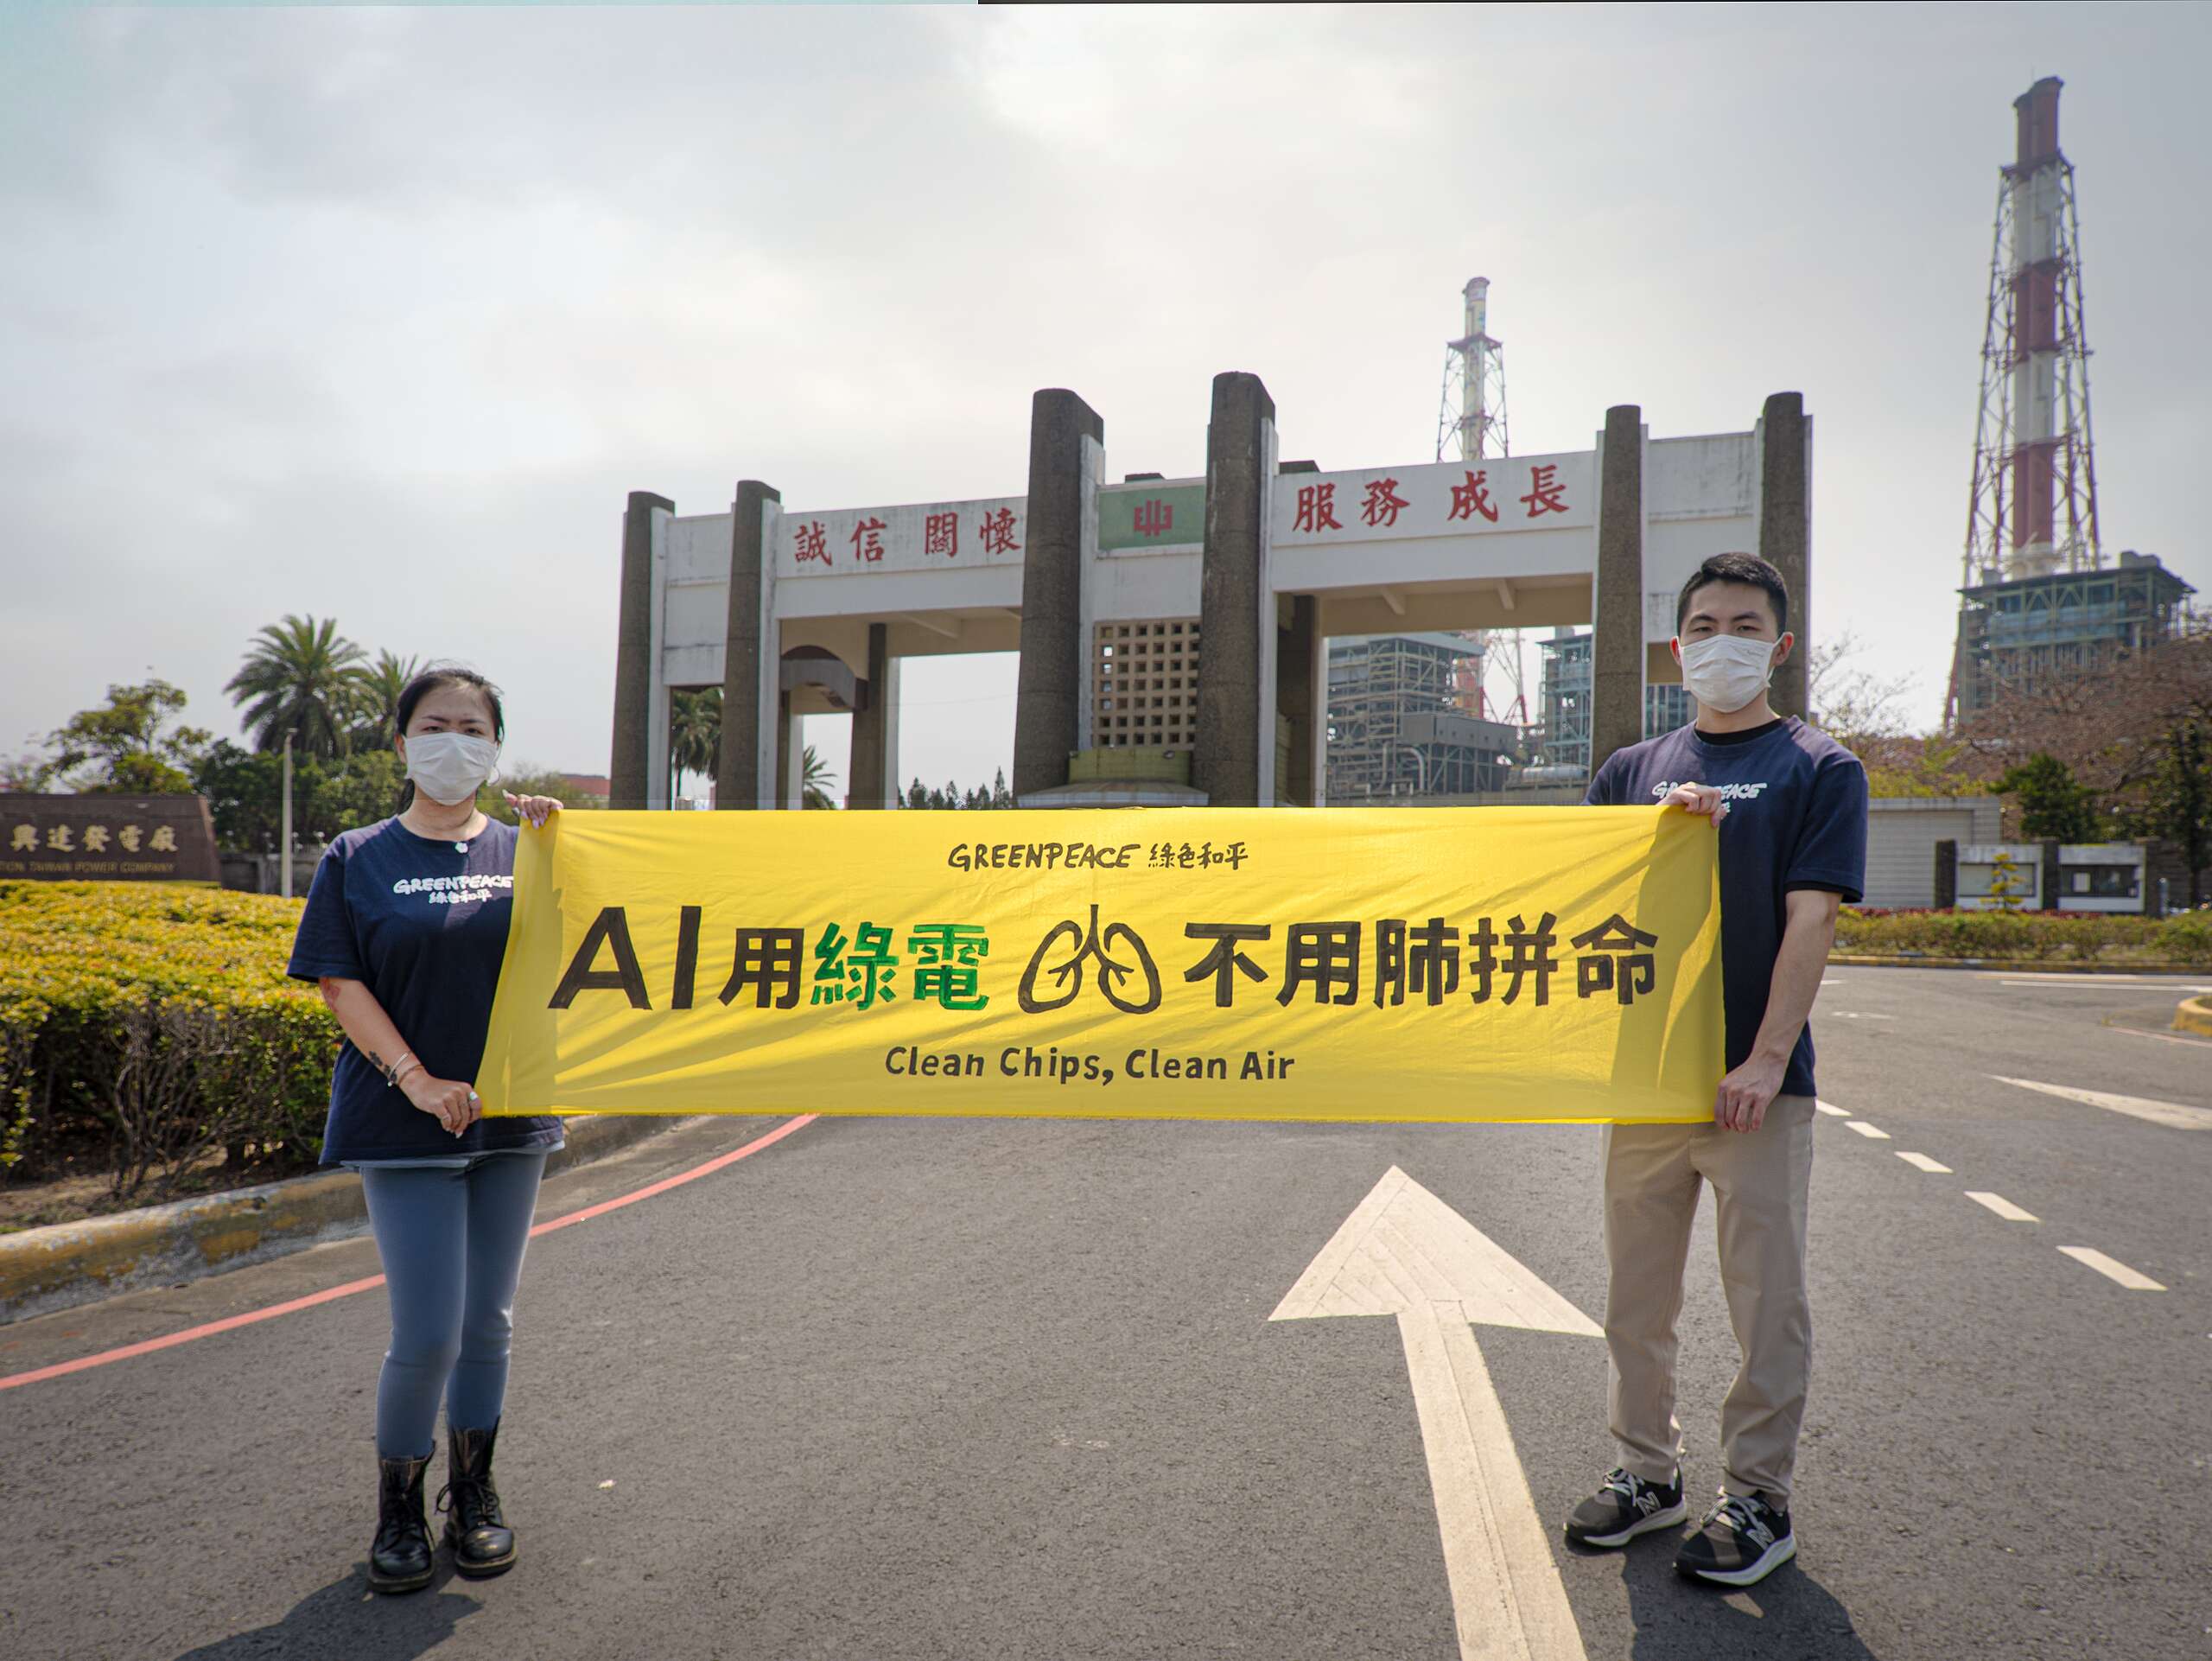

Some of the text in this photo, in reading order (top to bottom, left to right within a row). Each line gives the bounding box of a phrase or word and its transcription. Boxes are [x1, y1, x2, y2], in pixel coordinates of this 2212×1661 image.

[1651, 780, 1768, 799] GREACE
[948, 842, 1249, 872] GREENPEACE 綠色和平
[393, 874, 514, 895] GREENPEACE
[547, 905, 1660, 1011] AI用綠電 不用肺拼命
[885, 1046, 1295, 1086] Clean Chips, Clean Air
